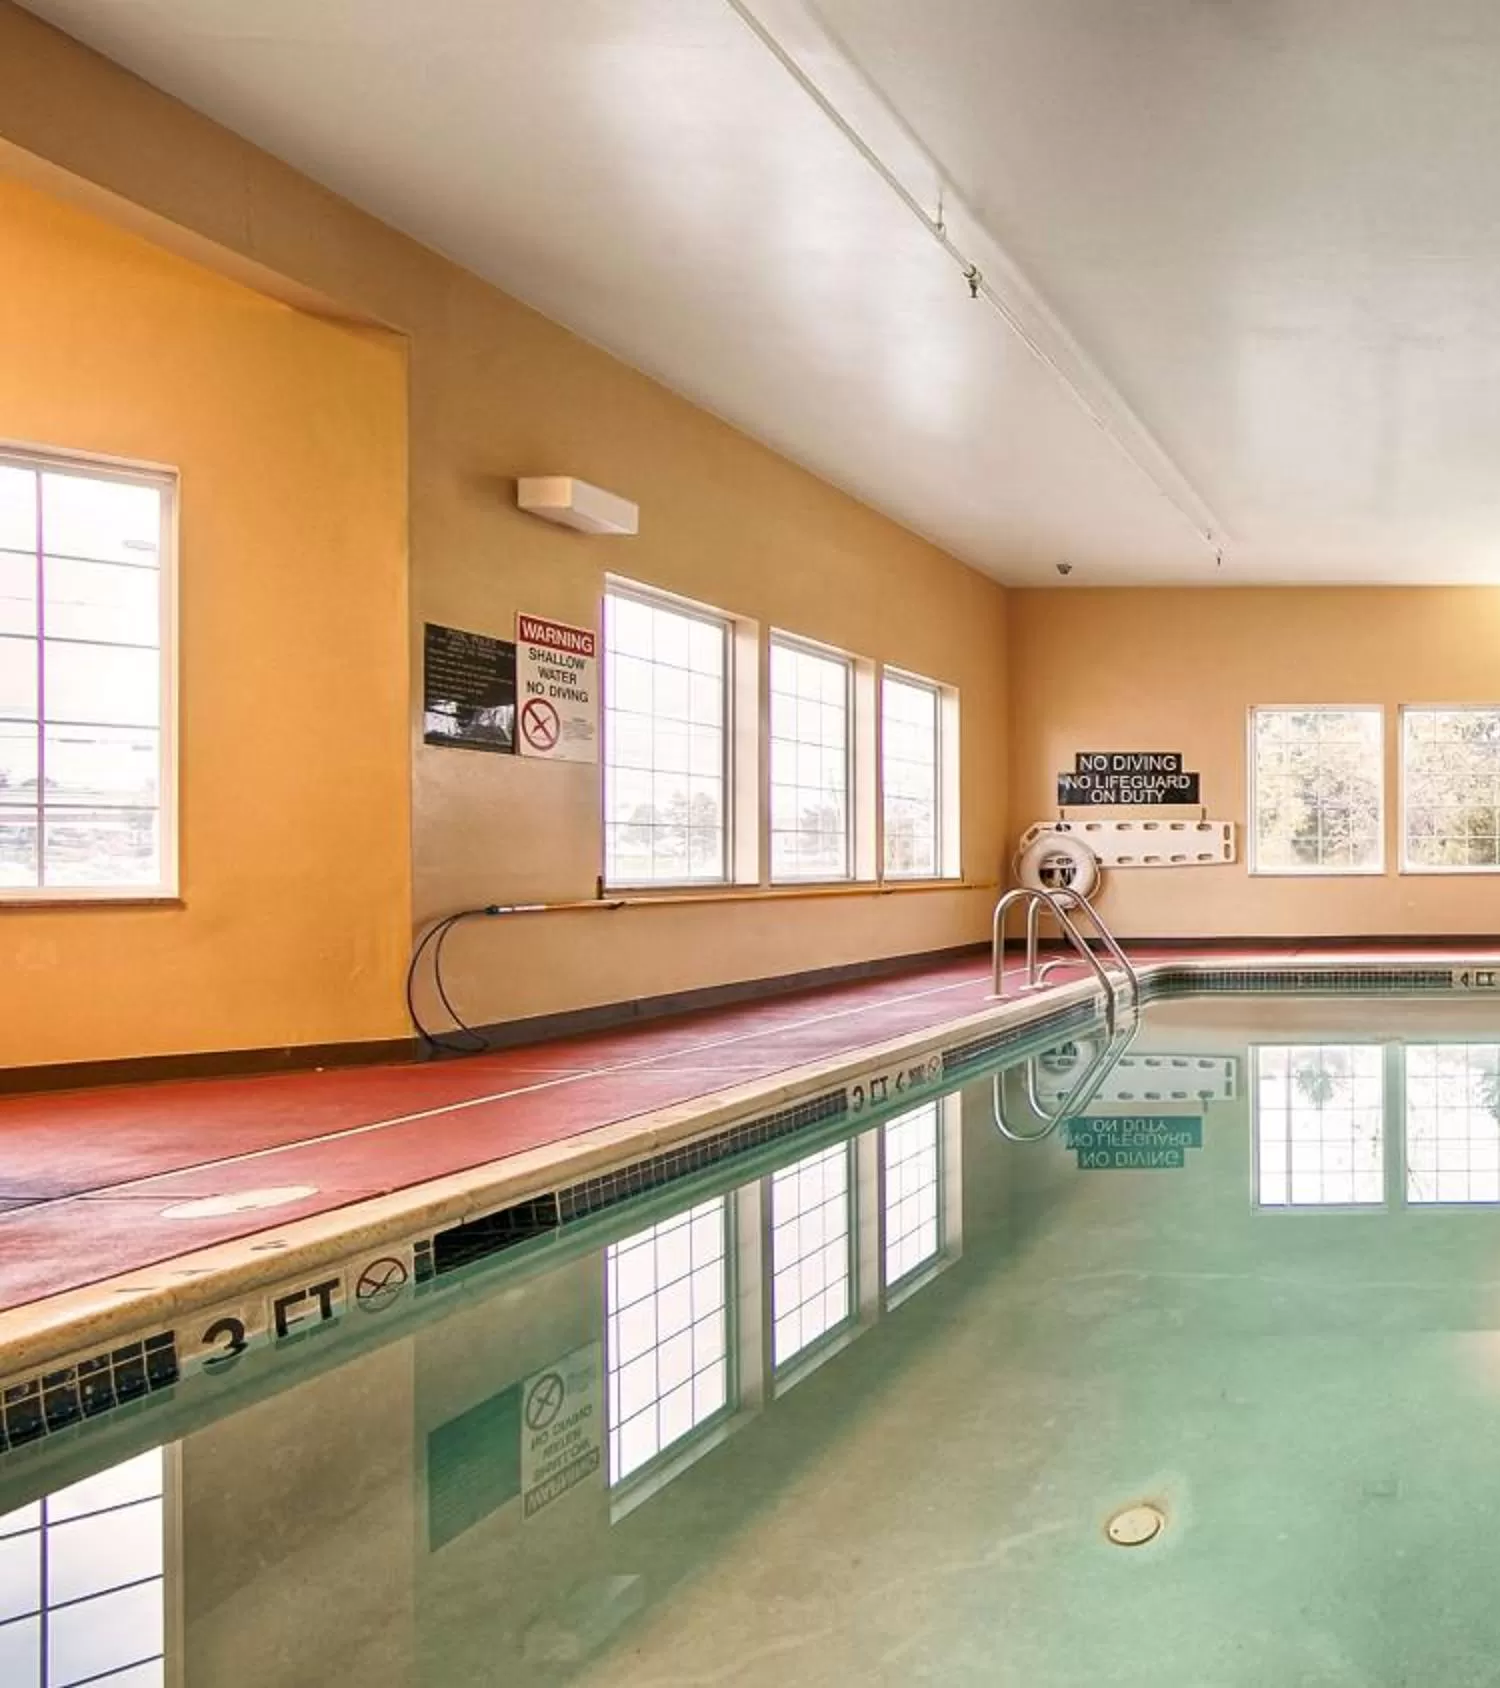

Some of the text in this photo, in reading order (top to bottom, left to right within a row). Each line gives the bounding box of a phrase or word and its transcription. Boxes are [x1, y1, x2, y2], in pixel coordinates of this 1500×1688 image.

[521, 620, 594, 654] WARNING
[528, 647, 586, 670] SHALLOW
[537, 666, 577, 685] WATER
[526, 681, 589, 703] NO DIVING
[1079, 755, 1177, 771] NO DIVING
[1065, 775, 1191, 789] NO LIFEGUARD
[1091, 790, 1165, 803] ON DUTY
[201, 1277, 341, 1365] 3 FT
